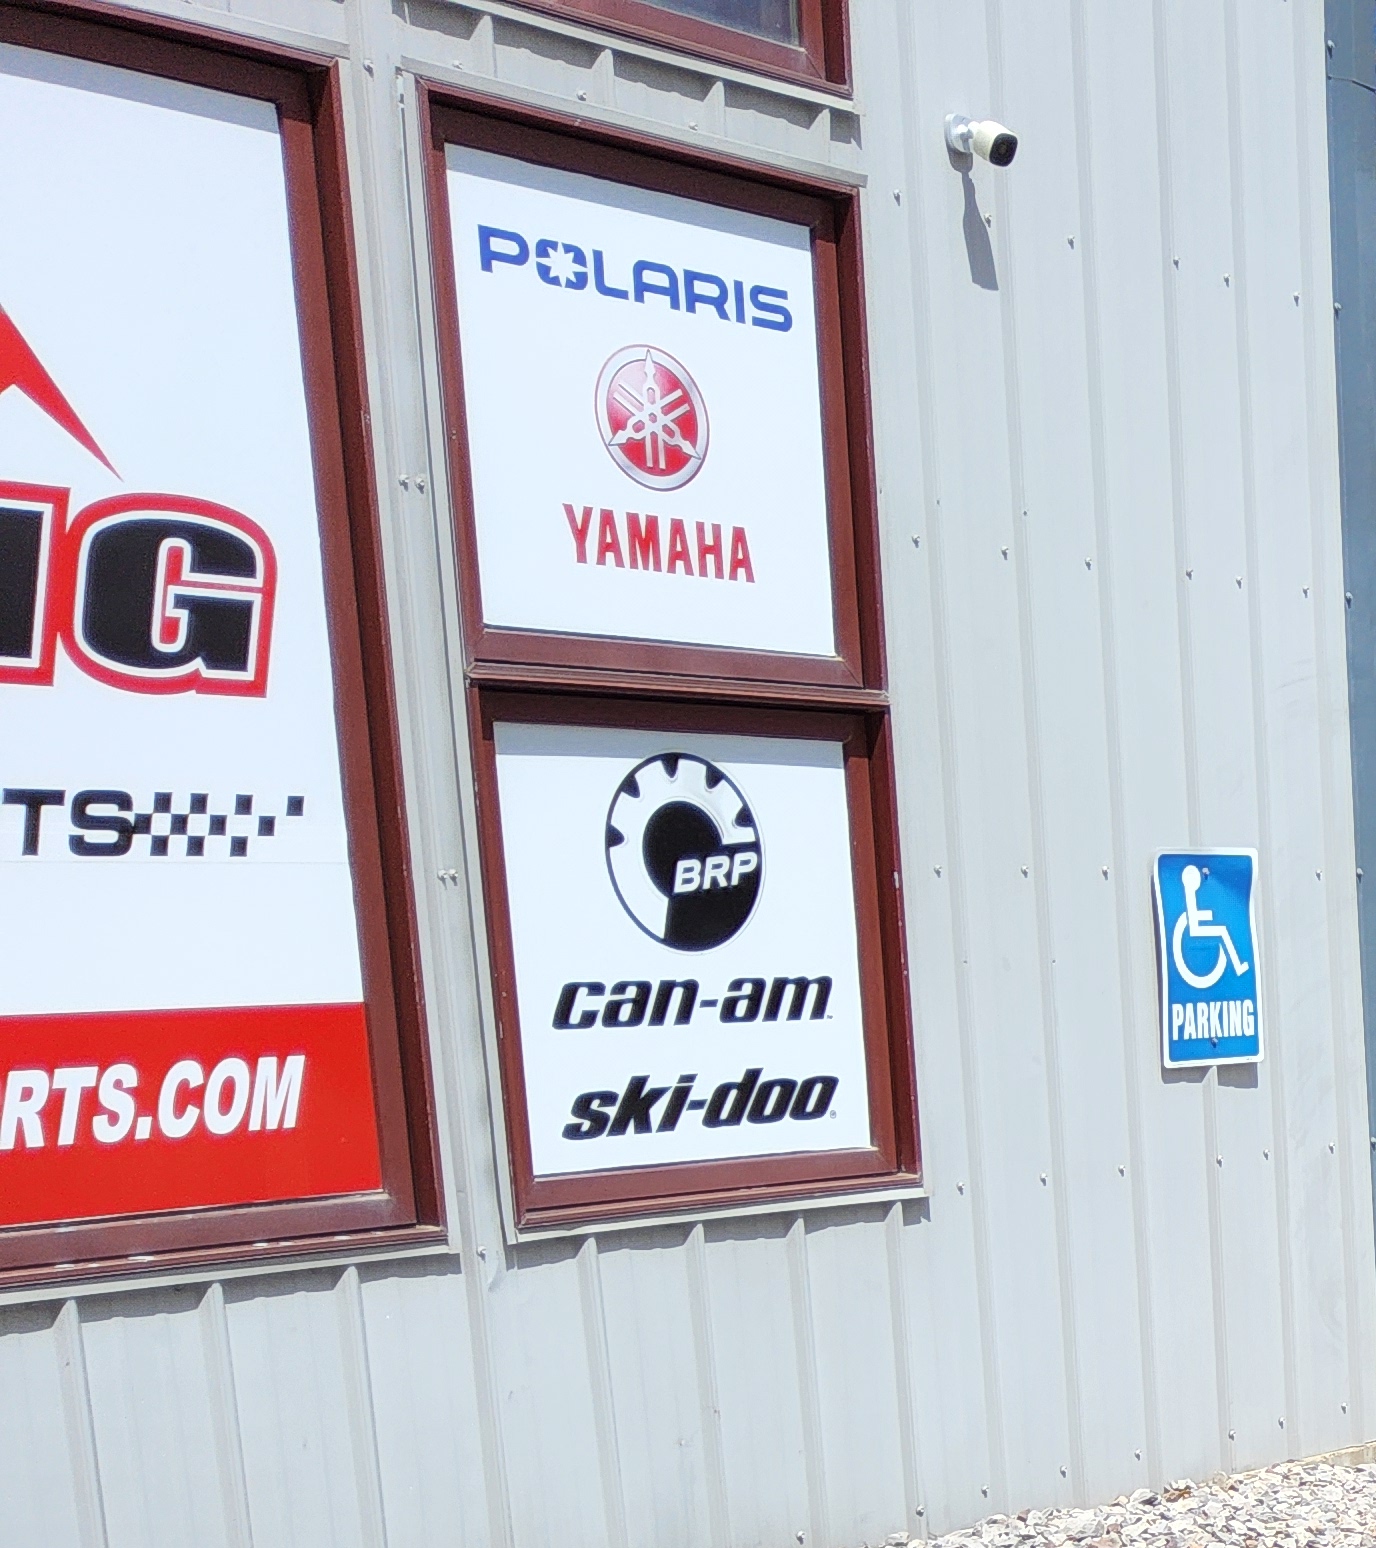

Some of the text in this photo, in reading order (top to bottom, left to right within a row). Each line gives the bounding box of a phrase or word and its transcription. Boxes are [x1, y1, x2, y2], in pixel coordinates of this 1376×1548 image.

[477, 223, 794, 333] POLARIS
[561, 502, 756, 584] YAMAHA
[673, 851, 758, 894] BRP
[551, 975, 833, 1030] can-am
[1171, 998, 1256, 1041] PARKING
[0, 1055, 306, 1150] RTS.COM
[561, 1067, 840, 1140] ski-doo
